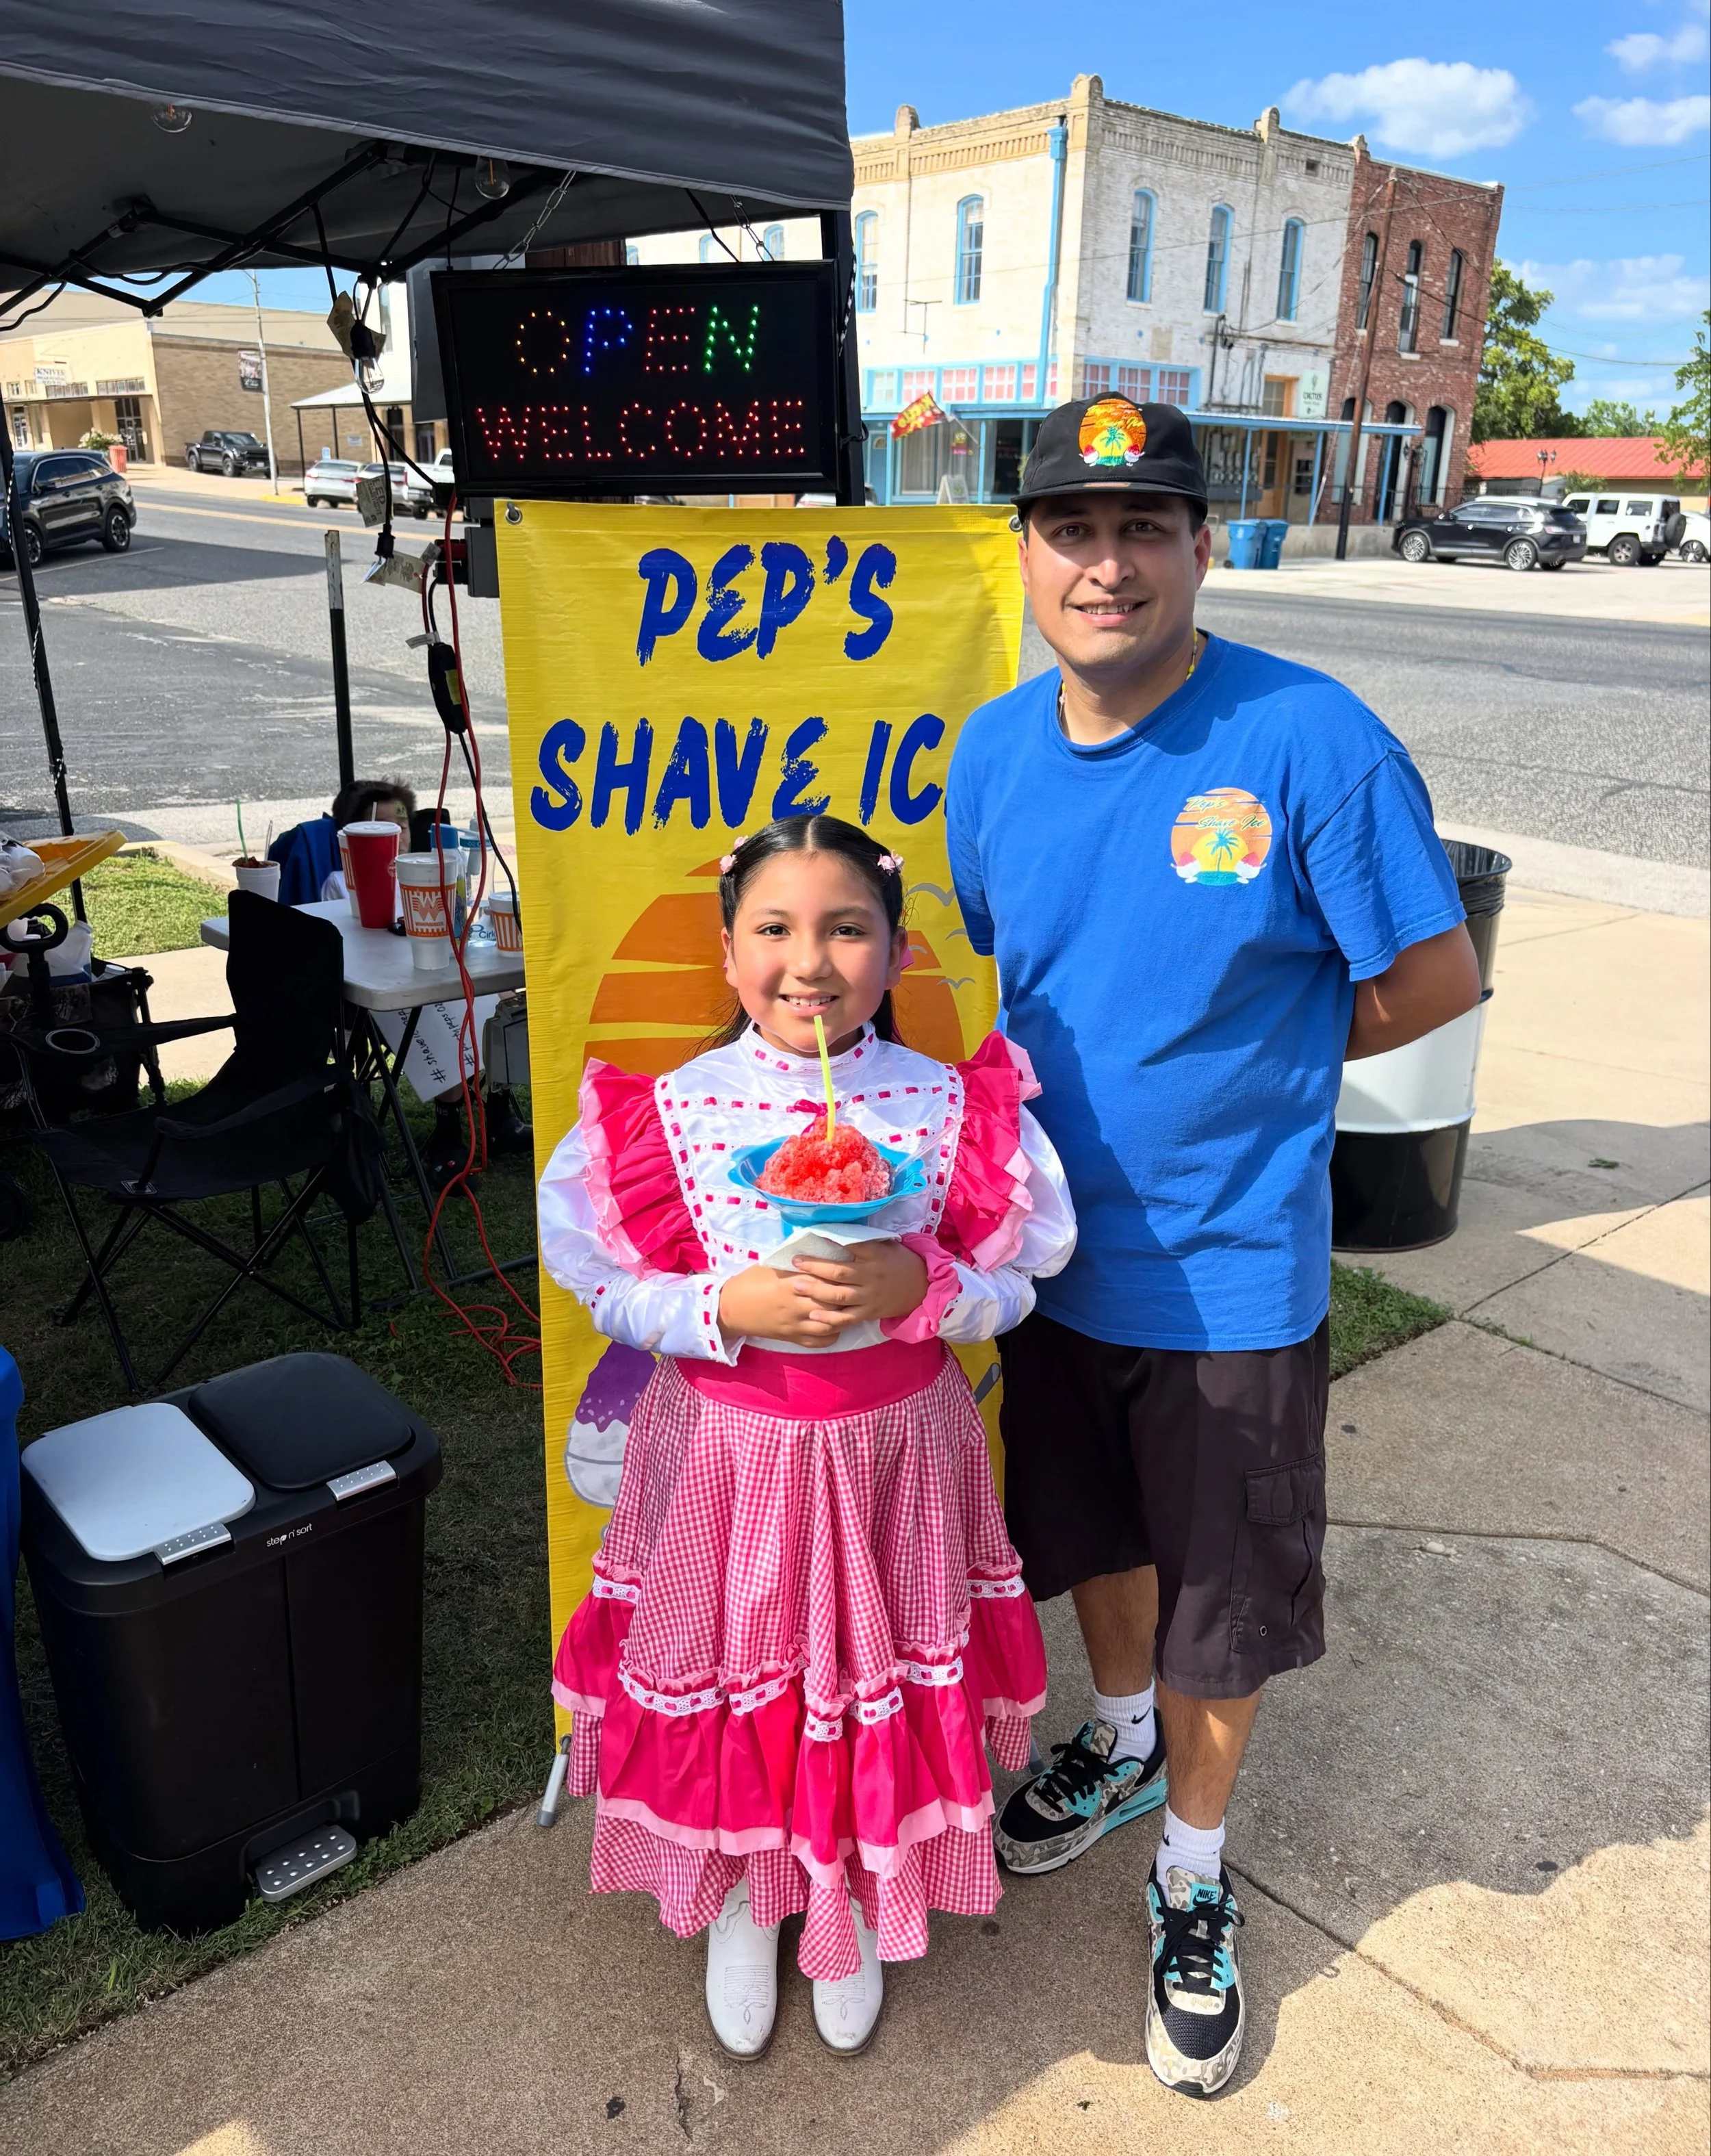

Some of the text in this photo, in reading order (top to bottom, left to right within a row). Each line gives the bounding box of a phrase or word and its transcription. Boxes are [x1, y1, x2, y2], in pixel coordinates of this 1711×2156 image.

[515, 304, 760, 374] OPEN
[476, 400, 808, 461] WELCOME
[636, 535, 897, 667] PEP'S
[530, 713, 948, 837] SHAVE IC
[266, 1534, 287, 1547] step
[296, 1523, 313, 1536] sort
[1197, 1888, 1215, 1899] NIKE
